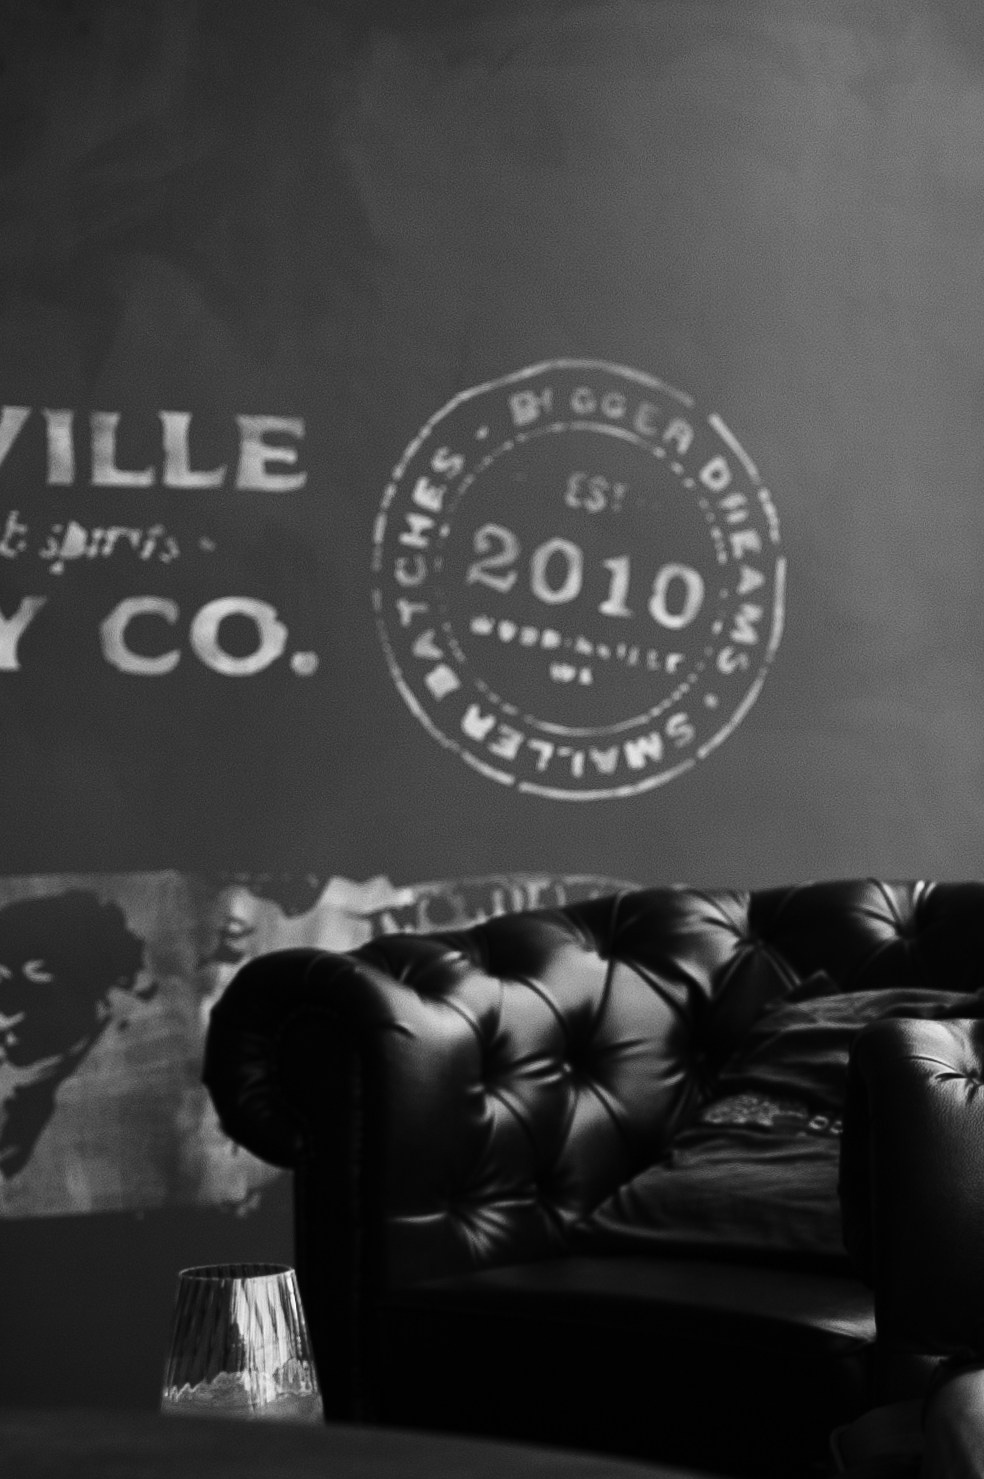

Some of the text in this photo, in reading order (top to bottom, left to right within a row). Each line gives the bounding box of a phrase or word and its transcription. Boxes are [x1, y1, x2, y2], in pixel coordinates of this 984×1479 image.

[467, 523, 705, 629] 2010
[100, 596, 320, 678] CO.
[462, 704, 695, 777] SMALLER
